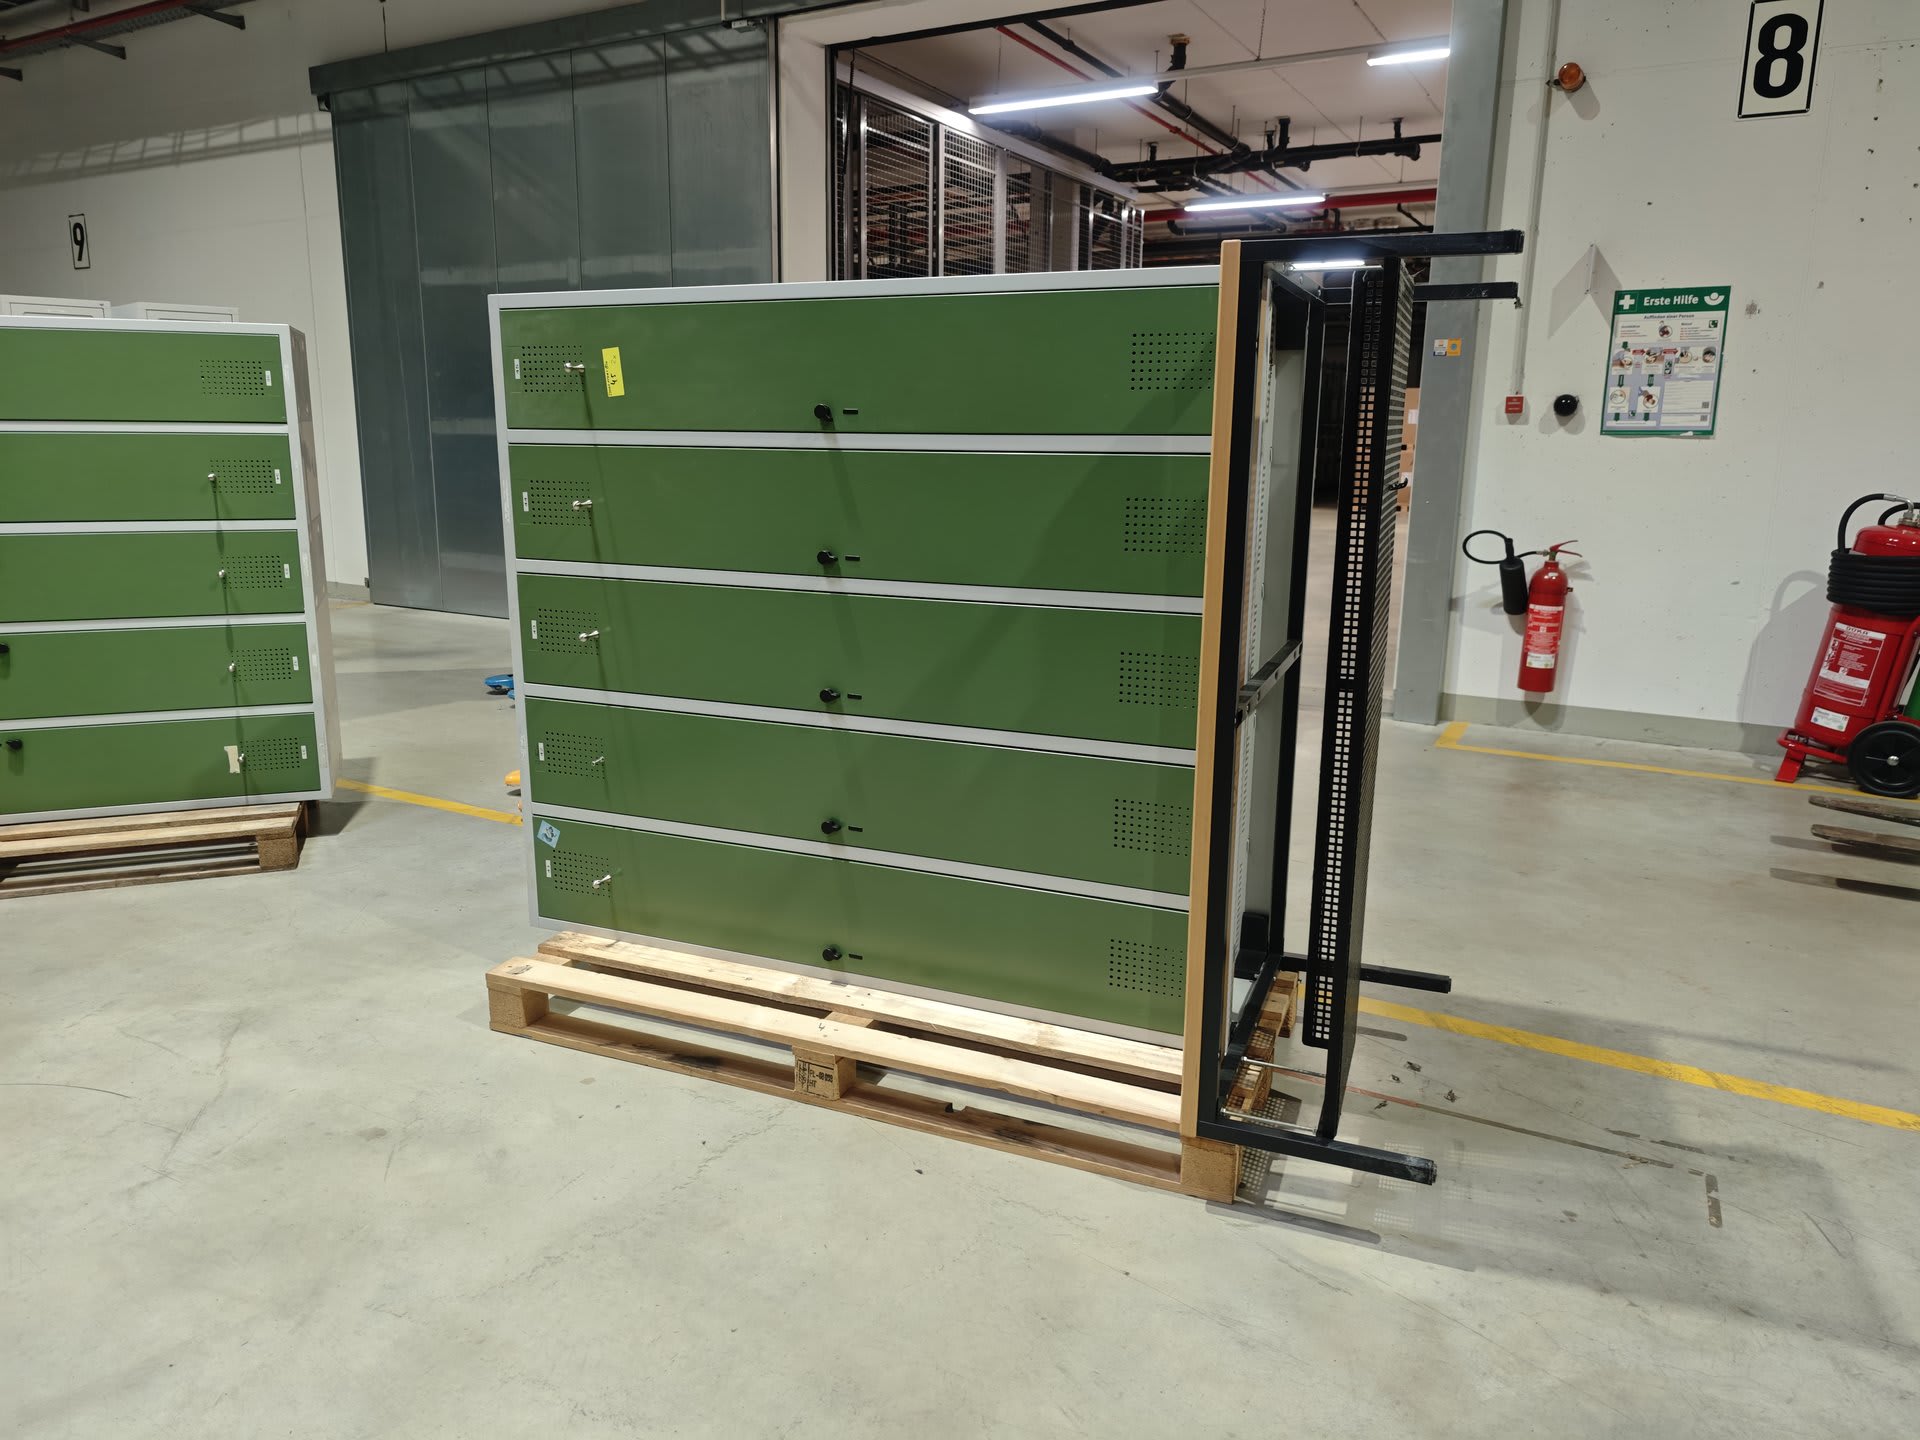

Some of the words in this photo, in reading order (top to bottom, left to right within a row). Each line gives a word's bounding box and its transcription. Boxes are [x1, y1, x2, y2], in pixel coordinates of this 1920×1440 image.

[1753, 13, 1808, 98] 8
[72, 222, 84, 261] 9
[1643, 296, 1670, 306] Erste
[1673, 294, 1699, 305] Hilfe
